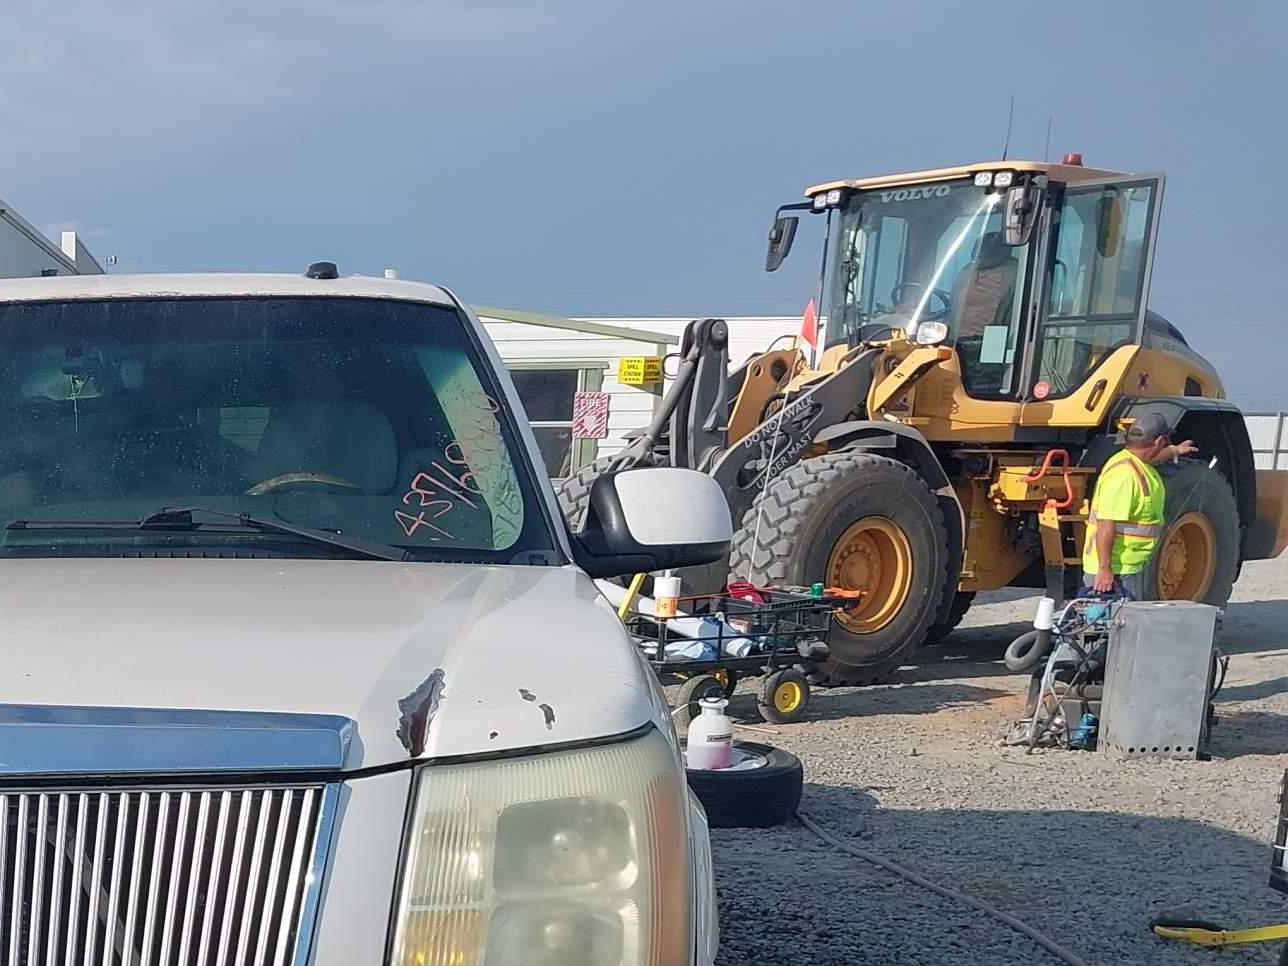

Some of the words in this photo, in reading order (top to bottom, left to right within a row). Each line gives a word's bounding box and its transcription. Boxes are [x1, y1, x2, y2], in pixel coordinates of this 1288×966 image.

[879, 184, 951, 203] VOLVO
[580, 399, 602, 408] FIRE
[744, 432, 761, 449] DO
[784, 395, 815, 420] WALK
[787, 431, 813, 460] MAST
